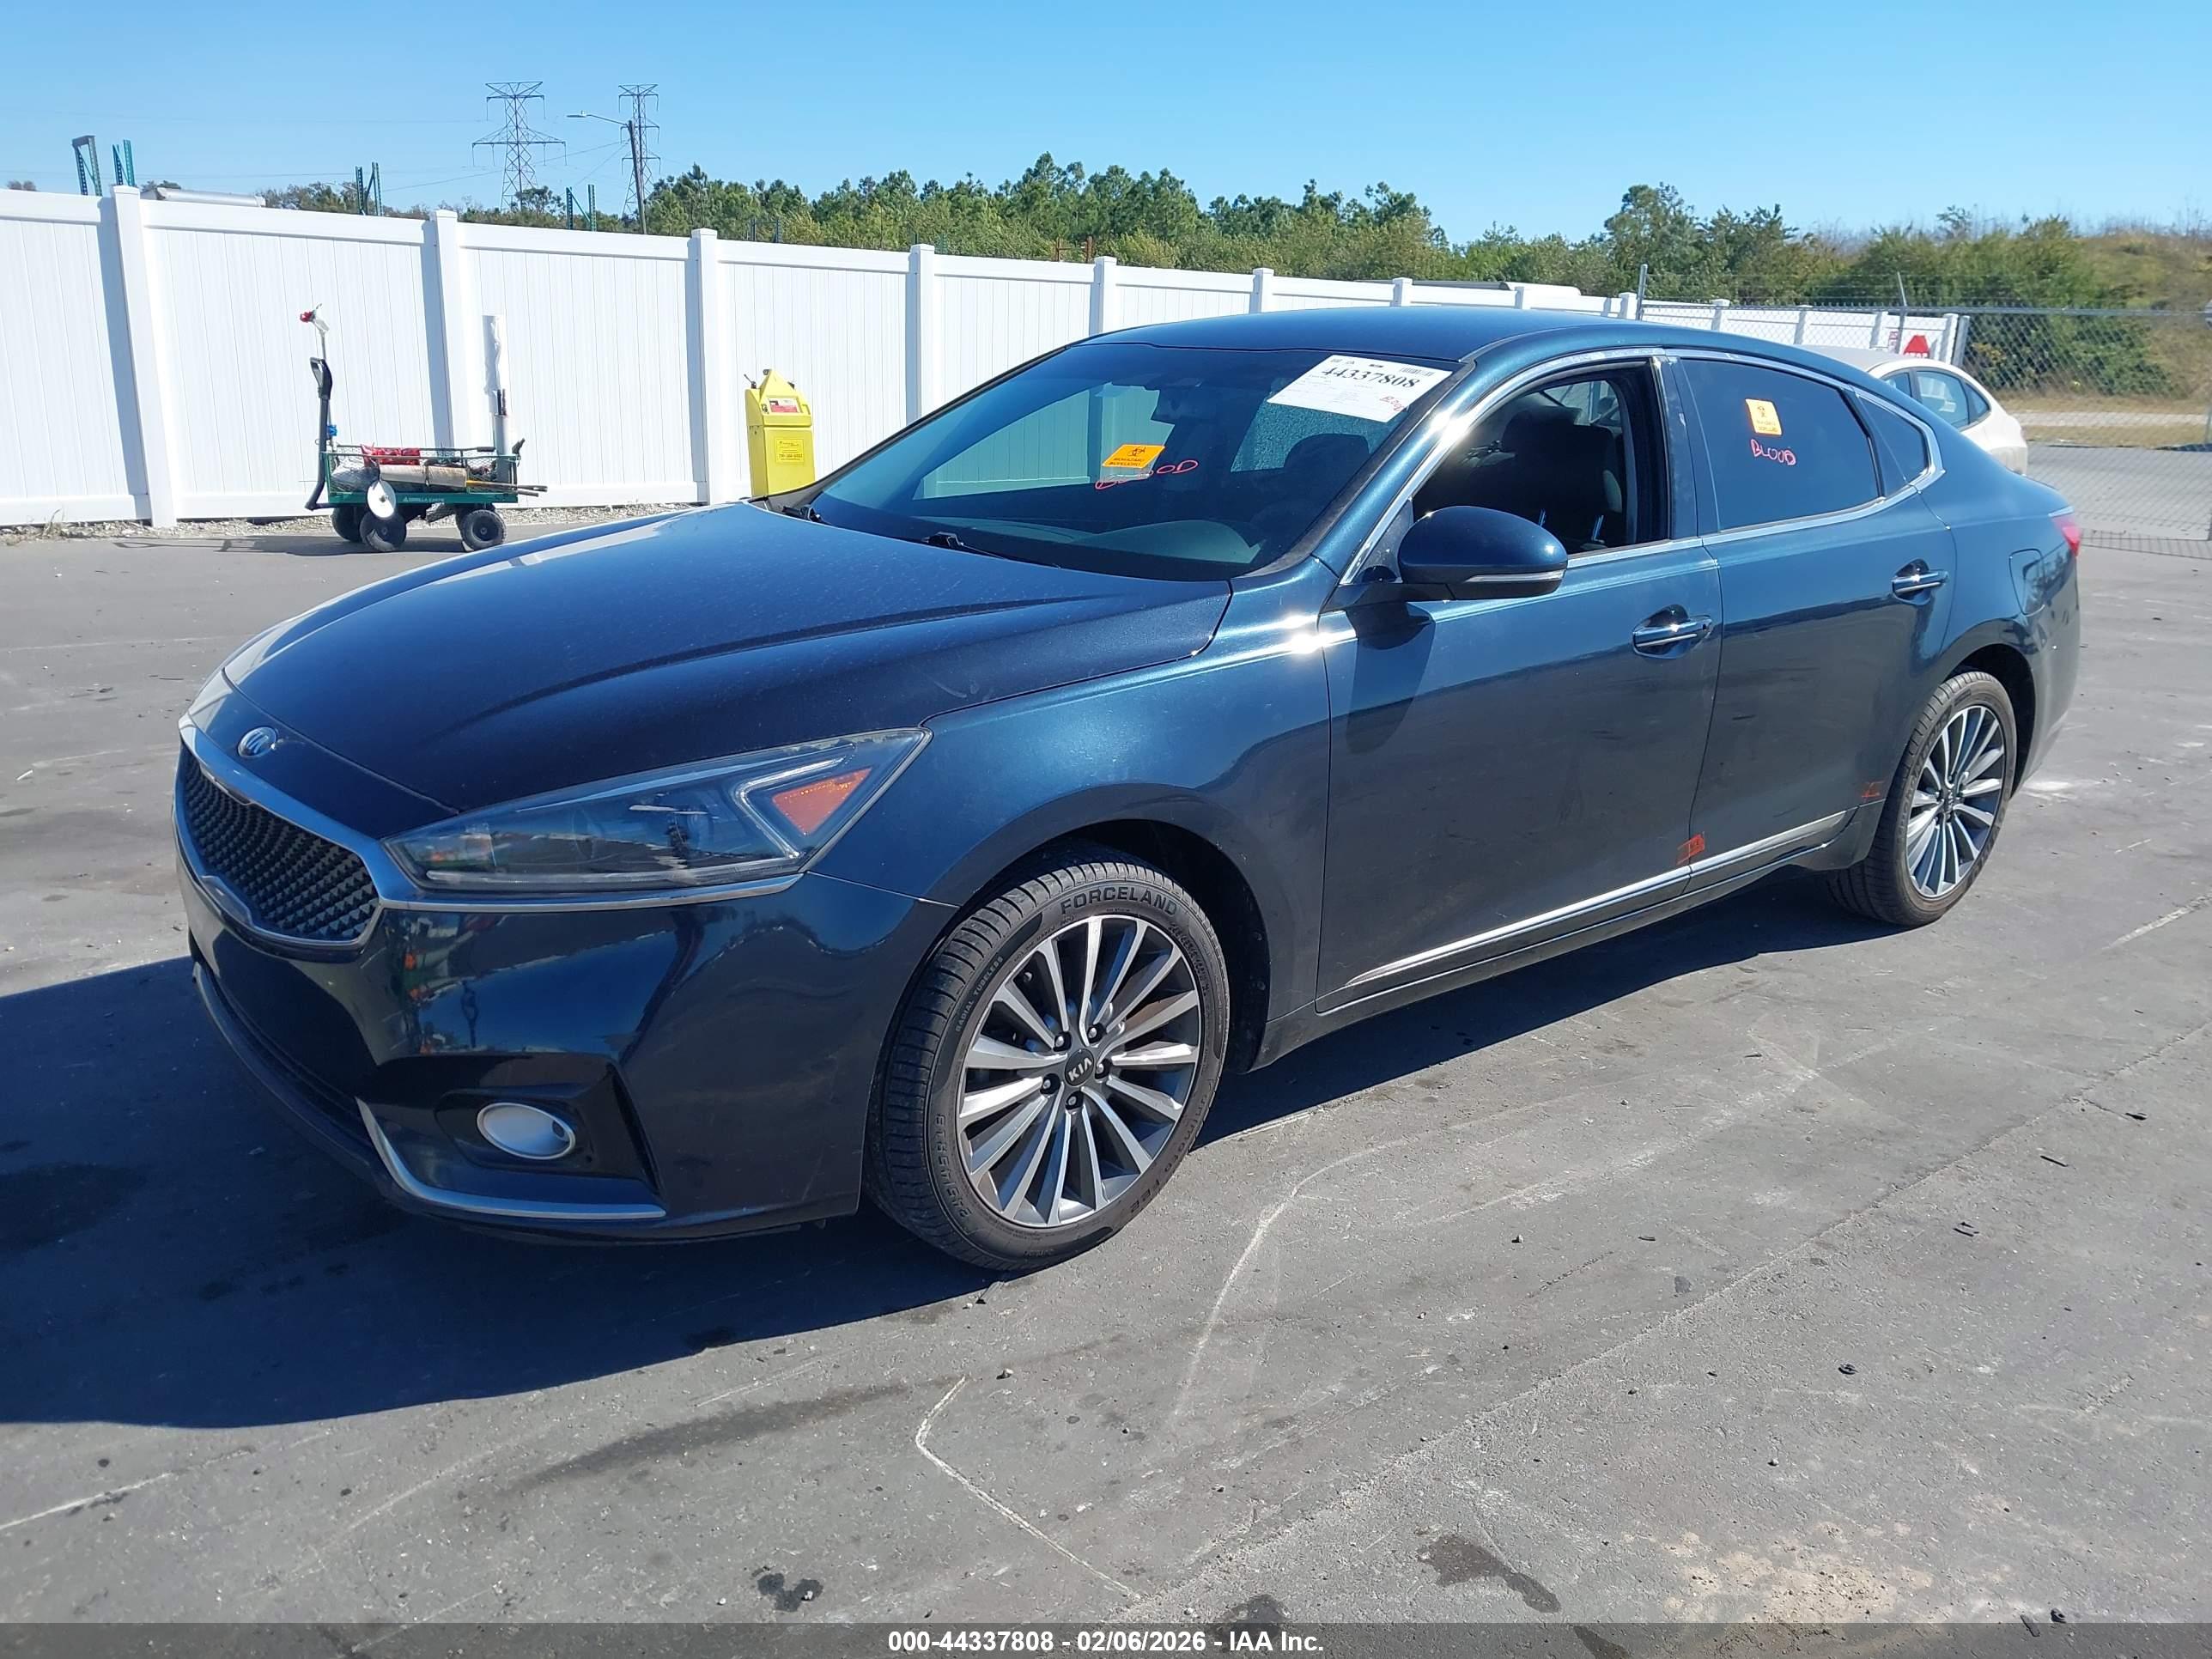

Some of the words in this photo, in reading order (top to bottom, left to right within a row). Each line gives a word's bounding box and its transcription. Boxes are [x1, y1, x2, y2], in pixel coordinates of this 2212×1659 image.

[1322, 367, 1420, 388] 44337808
[1751, 439, 1796, 465] BLOOD
[1060, 886, 1177, 916] FORCELAND
[1068, 1057, 1092, 1082] KIA
